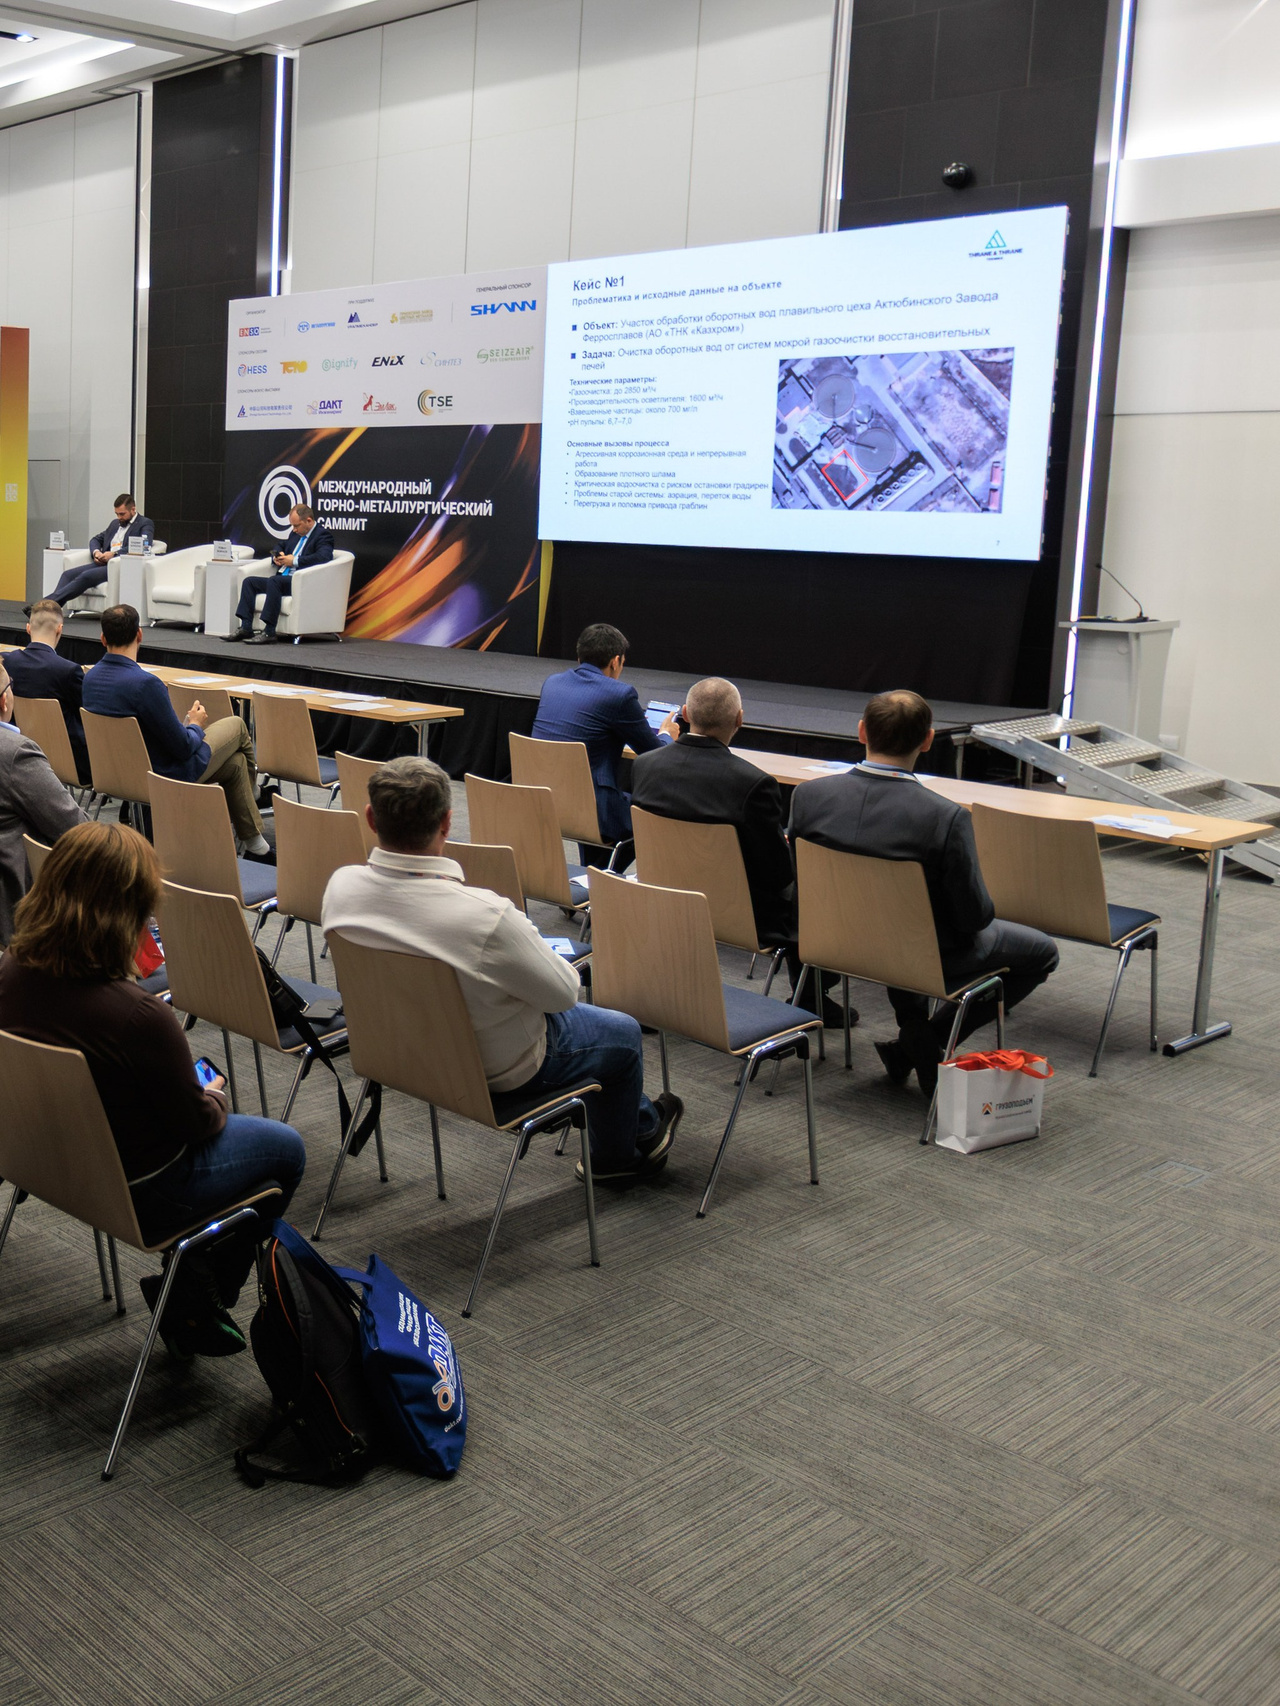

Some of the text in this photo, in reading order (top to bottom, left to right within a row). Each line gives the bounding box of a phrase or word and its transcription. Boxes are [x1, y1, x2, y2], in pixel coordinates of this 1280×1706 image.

[508, 282, 532, 290] СПОНСОР
[573, 276, 625, 291] Кейс №1
[572, 294, 632, 307] Проблематика
[642, 289, 687, 300] исходные
[689, 286, 725, 297] данные
[727, 284, 739, 292] на
[741, 280, 782, 292] объекте
[583, 291, 999, 331] Объект: Участок обработки оборотных вод плавильного цеха Актюбинского Завода
[583, 323, 744, 343] Ферросплавов (АО «ТНК «Казхром»)
[582, 327, 990, 360] Задача: Очистка оборотных вод от систем мокрой газоочистки восстановительных
[247, 365, 268, 375] HESS
[581, 361, 605, 372] печей
[570, 376, 657, 386] Технические параметры:
[624, 386, 641, 395] 2850
[429, 396, 453, 408] TSE
[689, 394, 707, 403] 1600
[319, 400, 343, 410] ДАКТ
[613, 407, 644, 416] частицы:
[645, 406, 666, 414] около
[668, 405, 681, 413] 700
[567, 440, 669, 449] Основные вызовы процесса
[575, 450, 616, 459] Агрессивная
[618, 450, 665, 459] коррозионная
[667, 450, 688, 459] среда
[697, 450, 746, 458] непрерывная
[575, 460, 597, 469] работа
[575, 470, 618, 478] Образование
[619, 471, 650, 479] плотного
[318, 479, 432, 497] МЕЖДУНАРОДНЫЙ
[574, 480, 615, 489] Критическая
[616, 481, 659, 489] водоочистка
[667, 482, 692, 490] риском
[694, 482, 731, 490] остановки
[733, 482, 769, 491] градирен
[574, 490, 751, 501] Проблемы старой системы: аэрация, переток воды
[317, 499, 493, 517] ГОРНО-МЕТАЛЛУРГИЧЕСКИЙ
[573, 500, 610, 509] Перегрузка
[617, 501, 646, 509] поломка
[648, 502, 677, 510] привода
